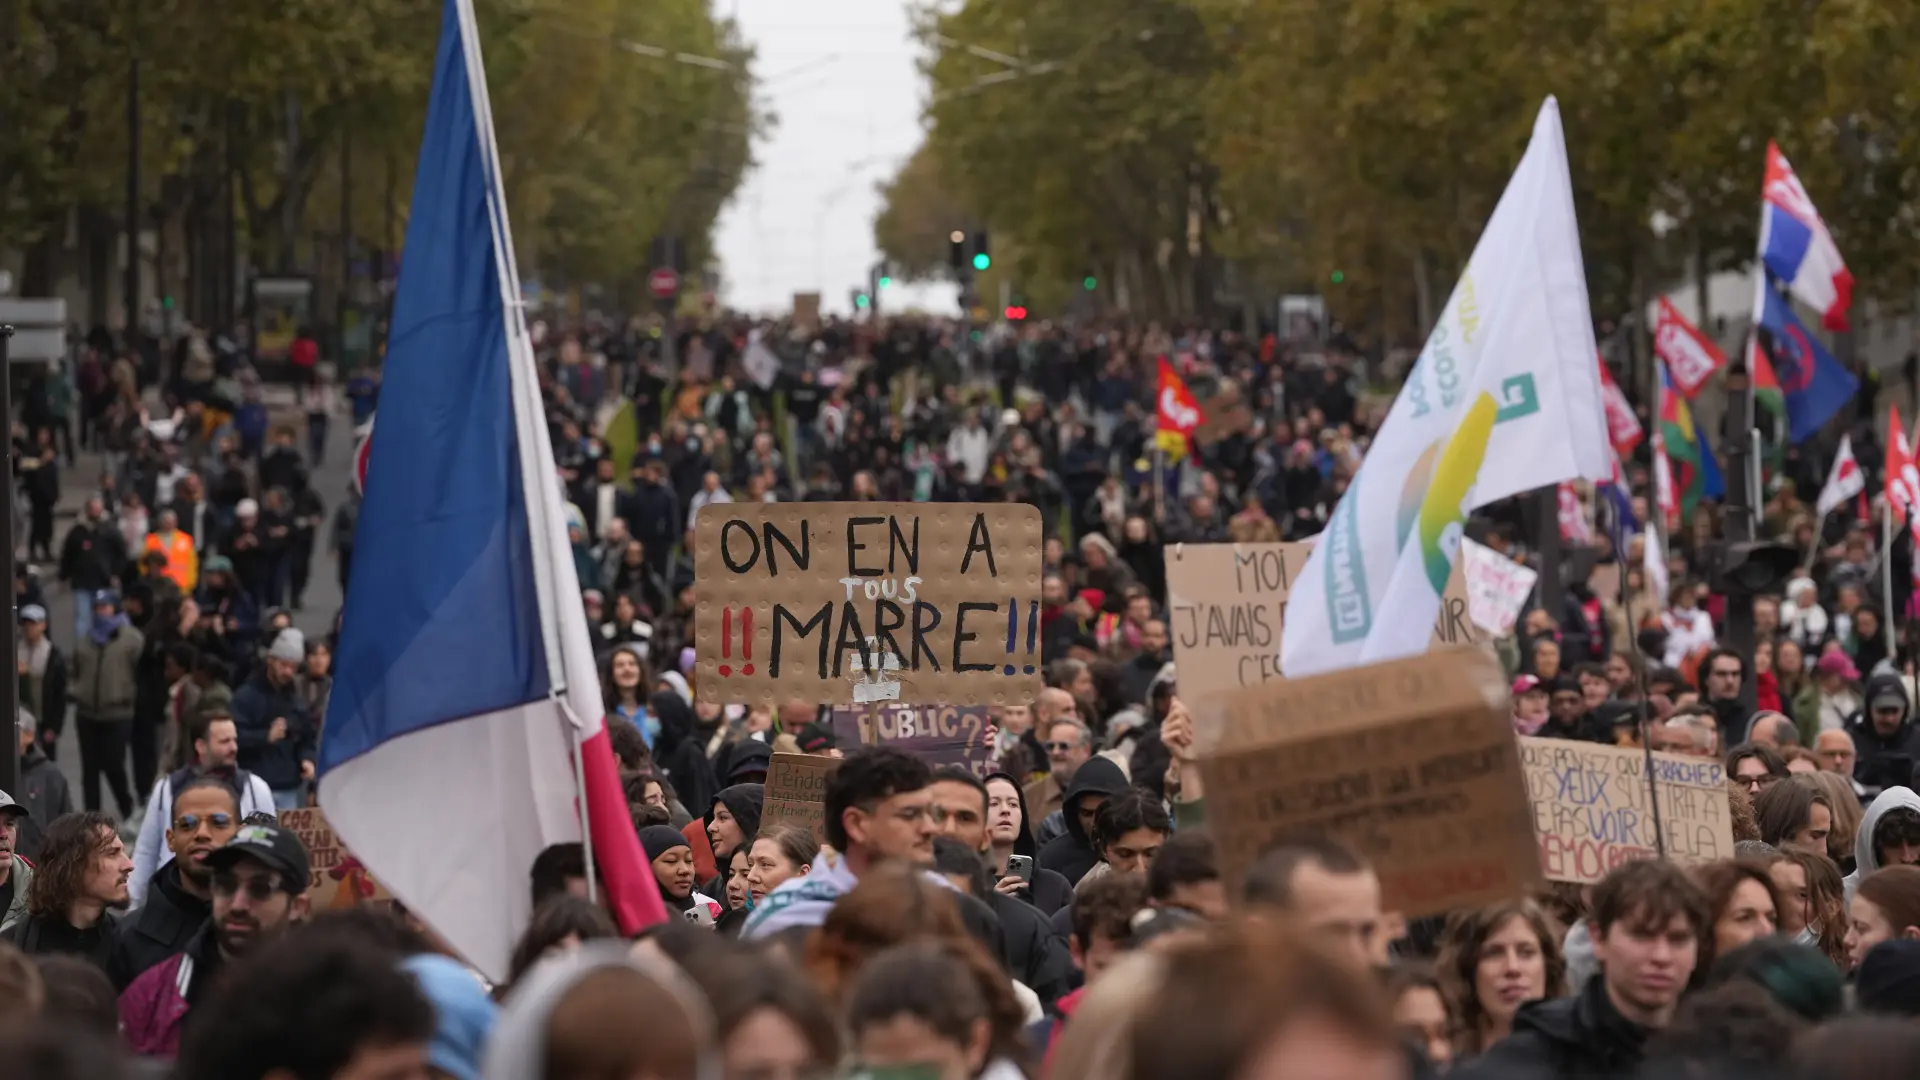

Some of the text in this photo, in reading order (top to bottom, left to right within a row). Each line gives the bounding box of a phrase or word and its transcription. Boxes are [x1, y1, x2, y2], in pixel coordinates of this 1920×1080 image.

[721, 512, 997, 577] ON EN A
[839, 577, 923, 604] TOUS
[1175, 602, 1272, 649] J'AVAIS
[775, 761, 824, 790] Penda
[1521, 744, 1553, 767] OUS
[1552, 766, 1611, 808] YEUX
[1551, 801, 1589, 837] PAS
[1587, 806, 1640, 844] VOIR
